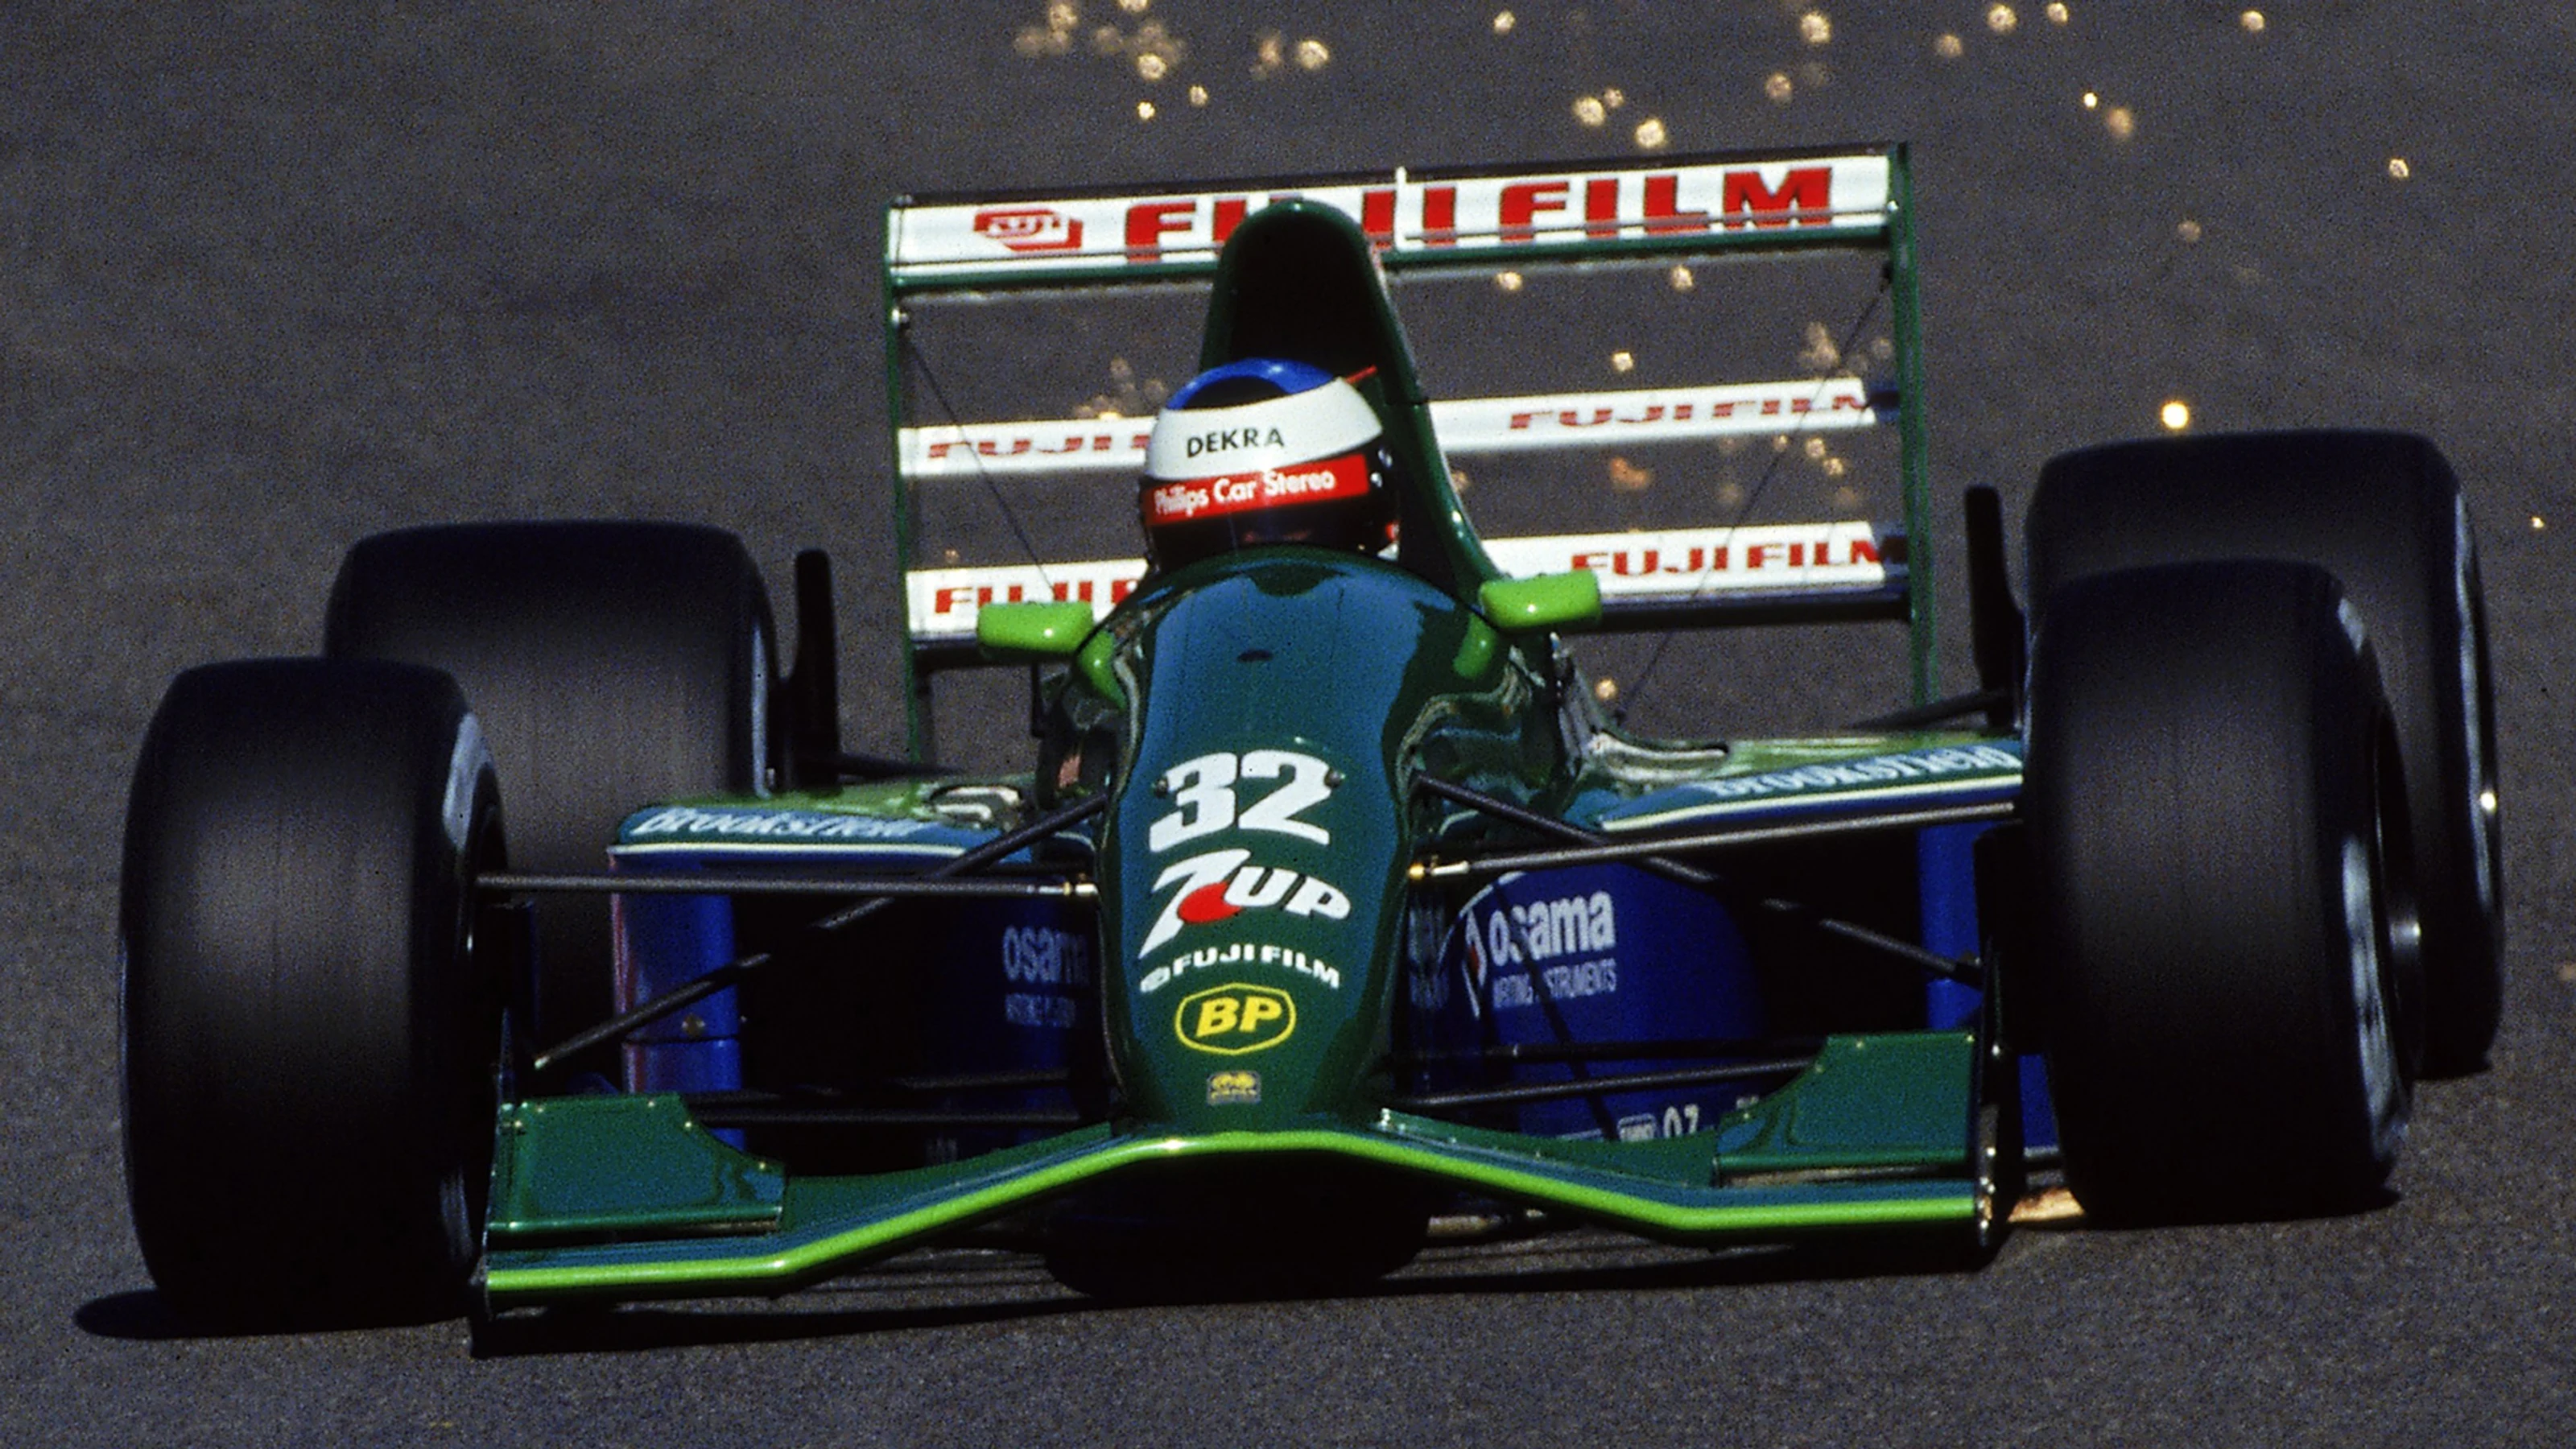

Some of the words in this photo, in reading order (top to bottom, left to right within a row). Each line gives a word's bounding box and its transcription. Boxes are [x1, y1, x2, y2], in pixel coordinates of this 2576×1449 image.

[1187, 427, 1284, 458] DEKRA
[1213, 477, 1257, 505] Car
[1264, 468, 1335, 496] Stereo
[1150, 749, 1333, 852] 32
[1195, 996, 1283, 1038] BP
